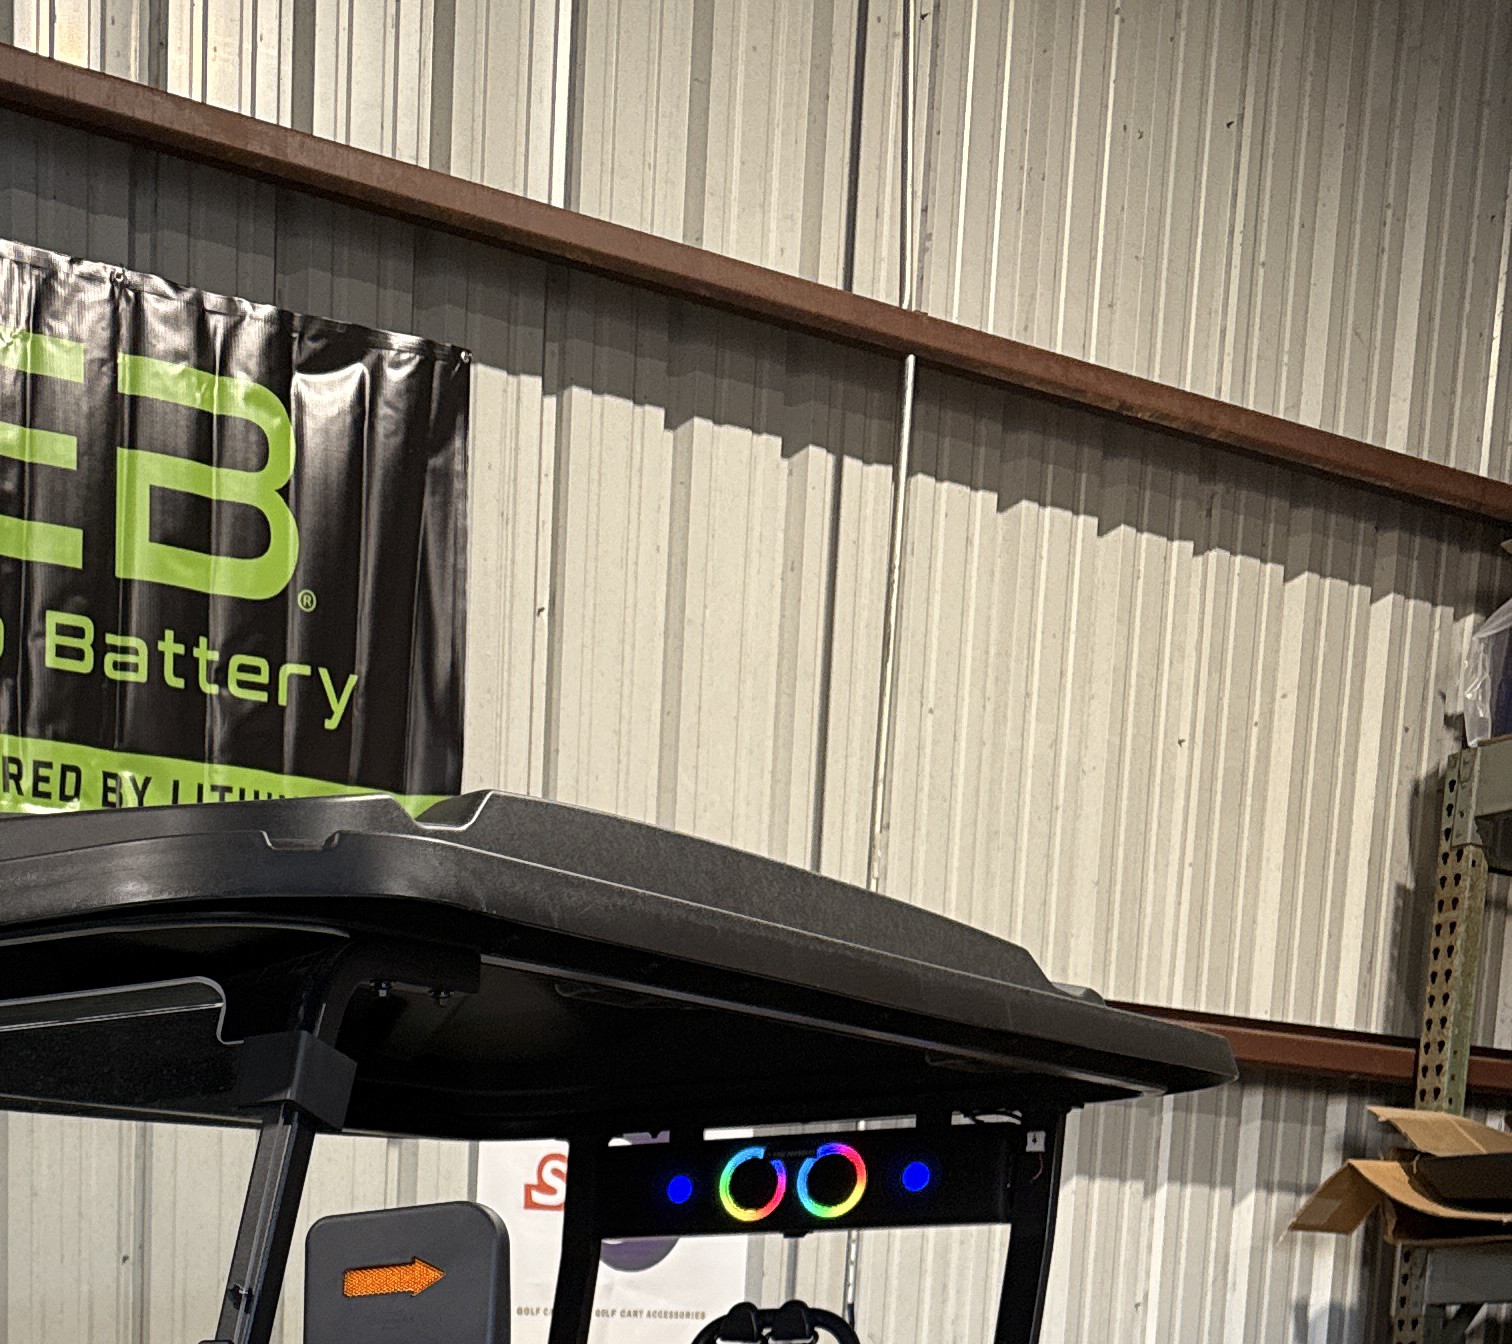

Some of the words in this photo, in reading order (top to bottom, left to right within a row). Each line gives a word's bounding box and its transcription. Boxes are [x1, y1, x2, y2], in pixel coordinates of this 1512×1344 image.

[47, 613, 357, 731] Battery
[102, 771, 152, 808] BY
[595, 1309, 617, 1318] GOLF
[619, 1310, 643, 1319] CART
[646, 1311, 706, 1320] ACCESSORIES
